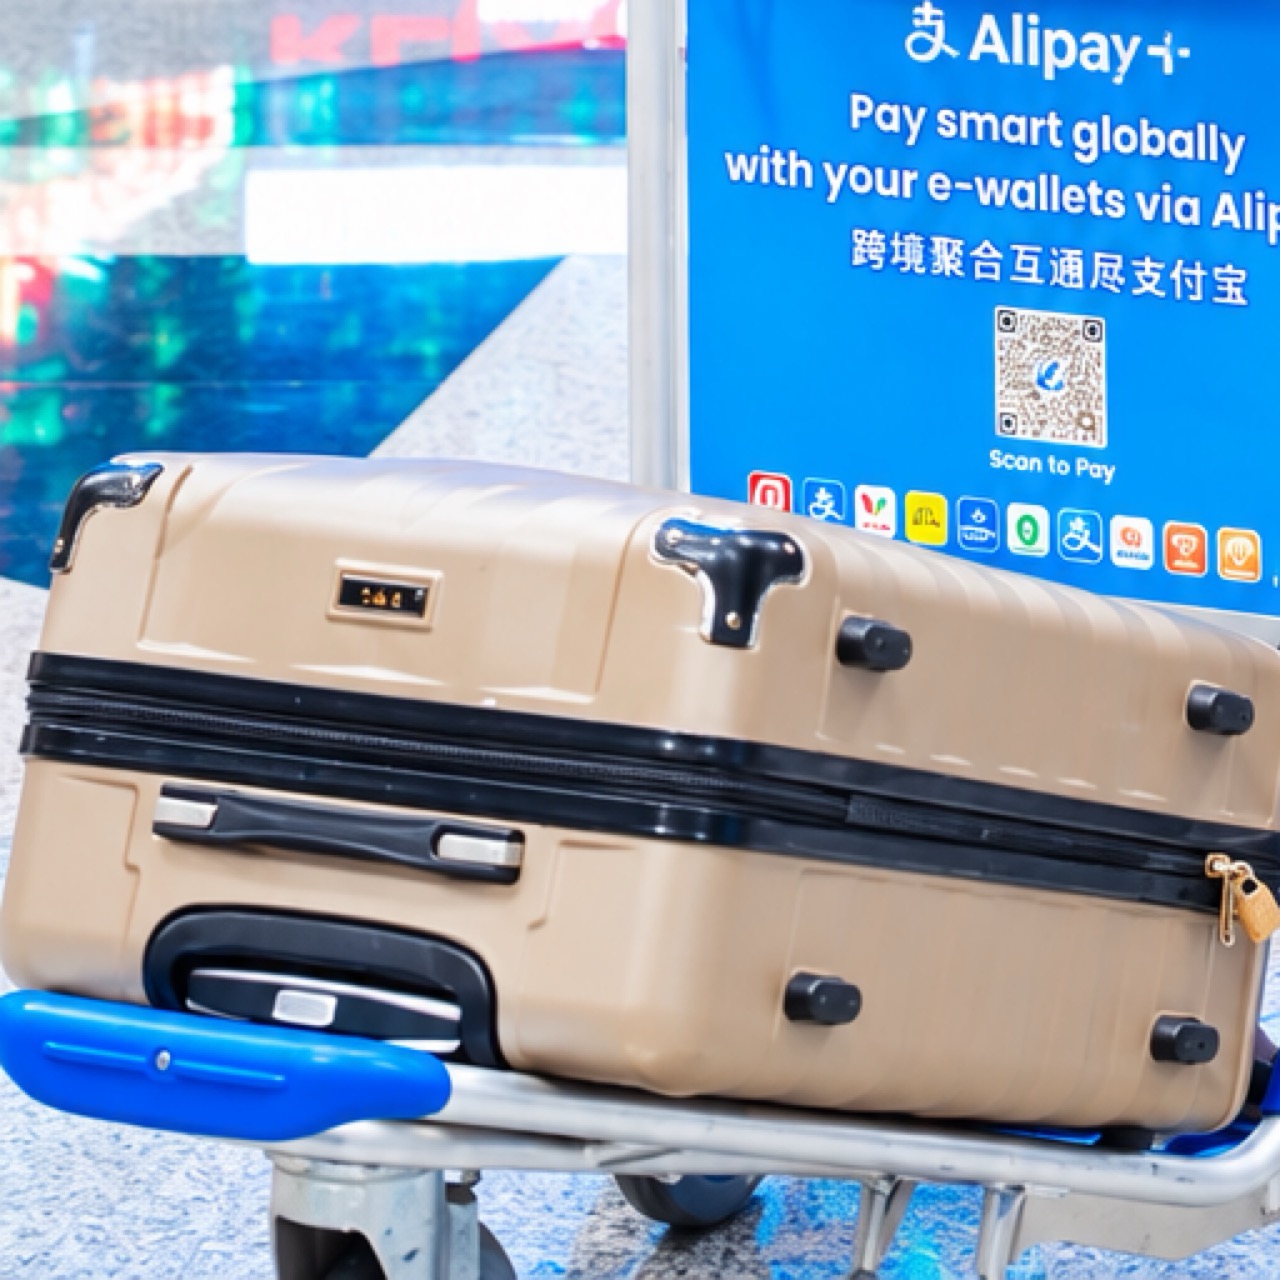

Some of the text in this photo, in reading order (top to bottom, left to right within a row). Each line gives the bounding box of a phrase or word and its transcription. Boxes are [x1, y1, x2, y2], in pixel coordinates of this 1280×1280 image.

[850, 93, 1246, 176] Pay smart globally
[724, 144, 814, 188] with
[822, 161, 919, 203] your
[927, 171, 1126, 219] e-wallets
[1134, 183, 1201, 226] via
[989, 449, 1116, 486] Scan to Pay
